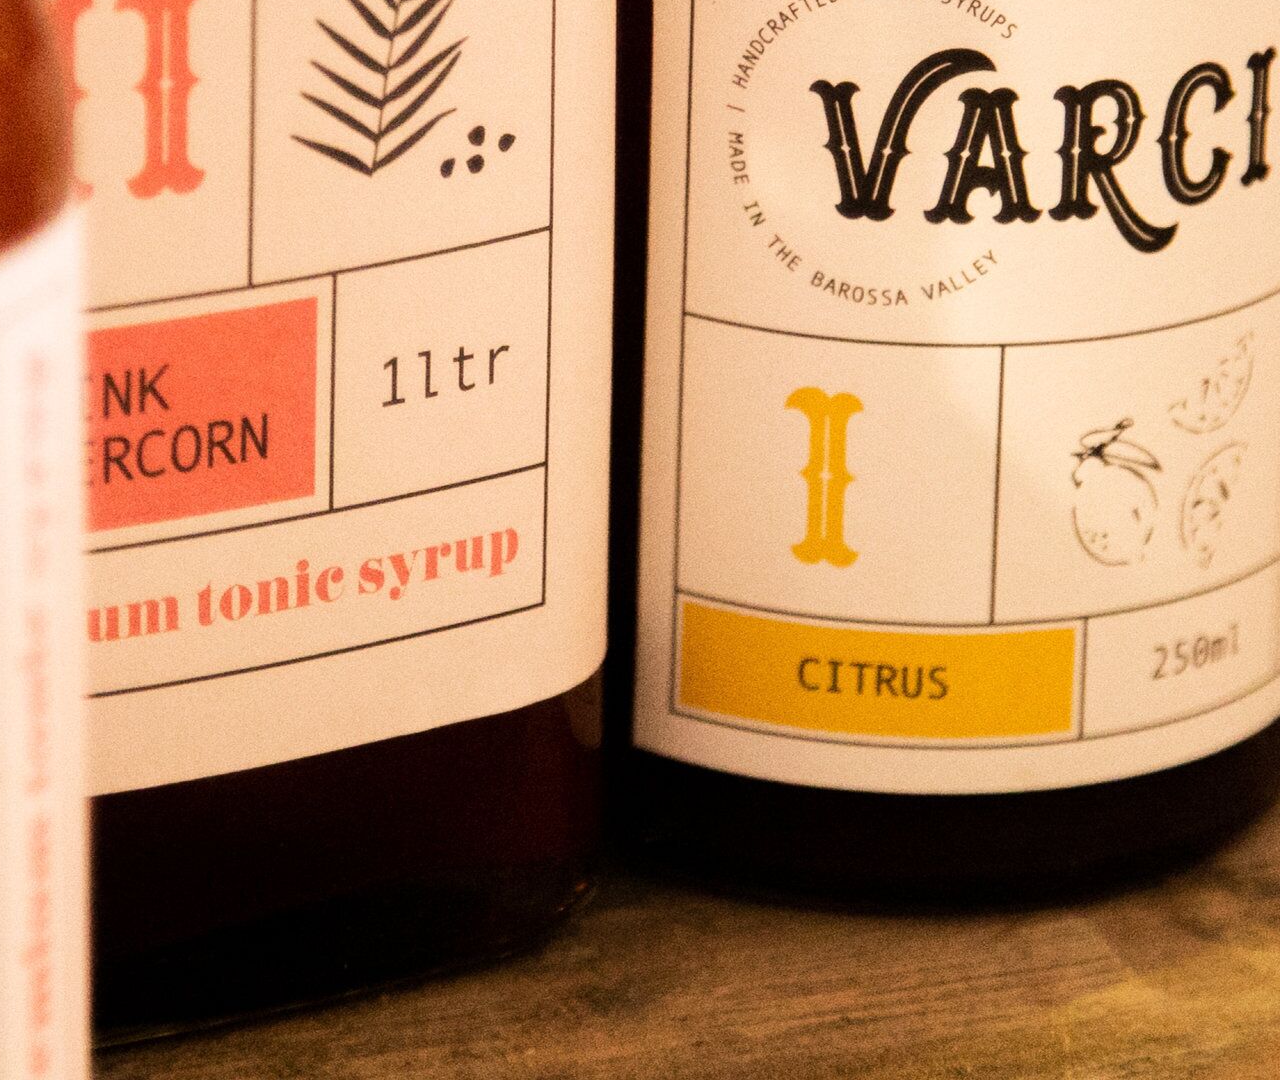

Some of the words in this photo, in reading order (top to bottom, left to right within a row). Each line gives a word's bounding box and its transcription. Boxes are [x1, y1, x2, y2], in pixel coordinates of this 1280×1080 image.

[809, 47, 1276, 252] VARCI
[728, 131, 750, 186] MADE
[744, 200, 766, 227] IN
[767, 234, 803, 272] THE
[810, 270, 909, 307] BAROSSA
[921, 249, 998, 300] VALLEY
[85, 363, 170, 419] NK
[382, 344, 511, 408] 1ltr
[783, 386, 864, 568] I
[196, 559, 344, 627] tonic
[357, 526, 519, 601] syrup
[797, 657, 950, 700] CITRUS
[1149, 623, 1241, 681] 250ml
